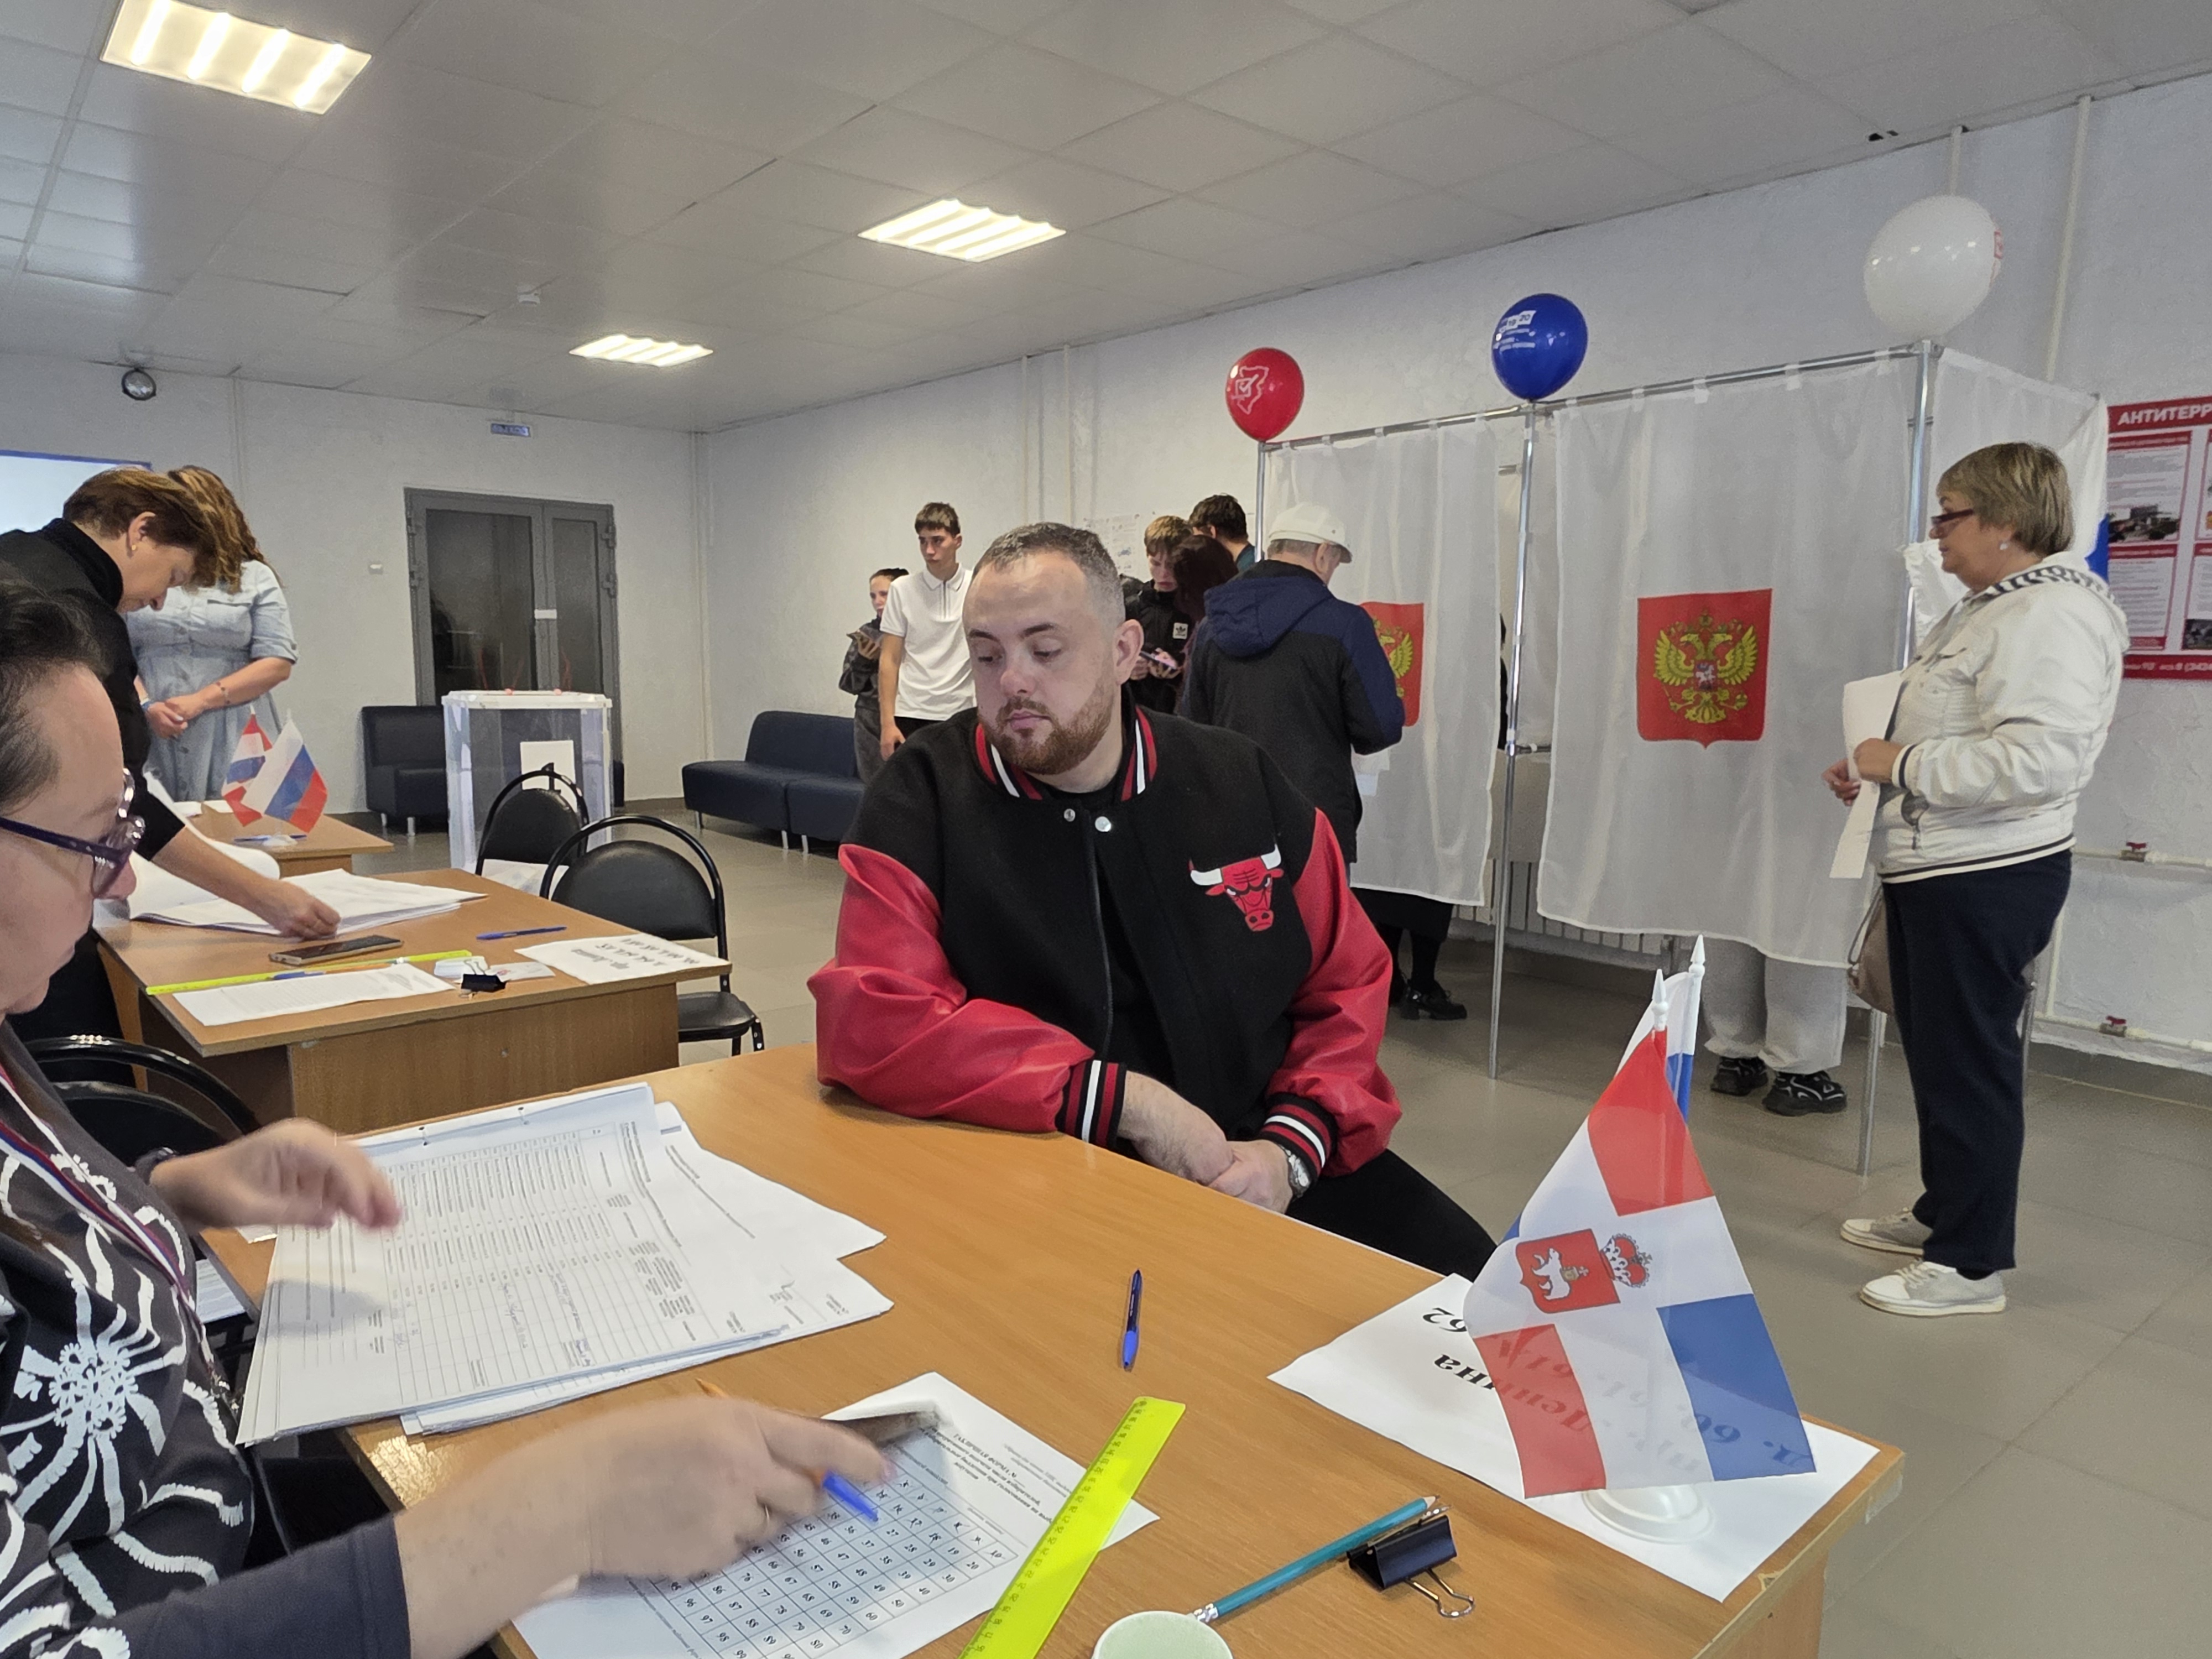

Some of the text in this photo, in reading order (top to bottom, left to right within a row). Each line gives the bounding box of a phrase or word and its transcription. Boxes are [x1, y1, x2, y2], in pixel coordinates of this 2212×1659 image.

[2117, 404, 2212, 426] АНТИТЕРР
[1423, 1307, 1467, 1333] 62
[844, 1525, 854, 1533] 36
[879, 1555, 893, 1564] 38
[898, 1571, 911, 1579] 39
[904, 1543, 917, 1552] 28
[922, 1558, 936, 1567] 29
[941, 1573, 955, 1582] 30
[966, 1561, 979, 1569] 20
[768, 1560, 779, 1569] 66
[802, 1593, 815, 1601] 68
[820, 1609, 832, 1618] 69
[776, 1533, 878, 1620] 55 56 57 58 59 60
[855, 1568, 867, 1577] 48
[891, 1599, 904, 1607] 50
[684, 1598, 696, 1607] 96
[700, 1614, 713, 1624] 97
[717, 1632, 729, 1642] 98
[712, 1585, 726, 1594] 86
[728, 1601, 742, 1610] 87
[745, 1618, 759, 1628] 88
[763, 1635, 776, 1645] 89
[741, 1572, 823, 1648] 76 77 78 79 80
